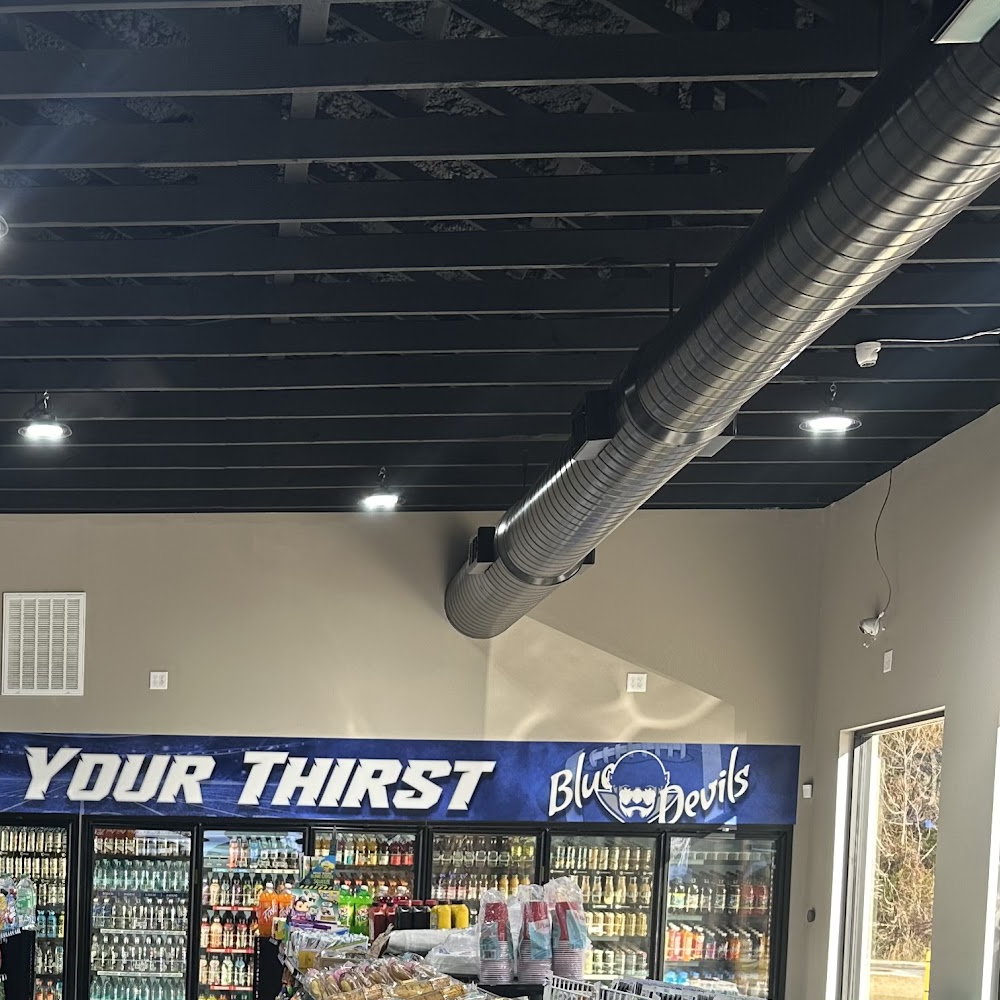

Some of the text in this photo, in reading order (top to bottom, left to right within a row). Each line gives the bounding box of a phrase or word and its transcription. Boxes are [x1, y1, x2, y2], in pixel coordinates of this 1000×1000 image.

[23, 746, 217, 804] YOUR
[237, 751, 497, 811] THIRST
[549, 746, 751, 824] Blue Devils
